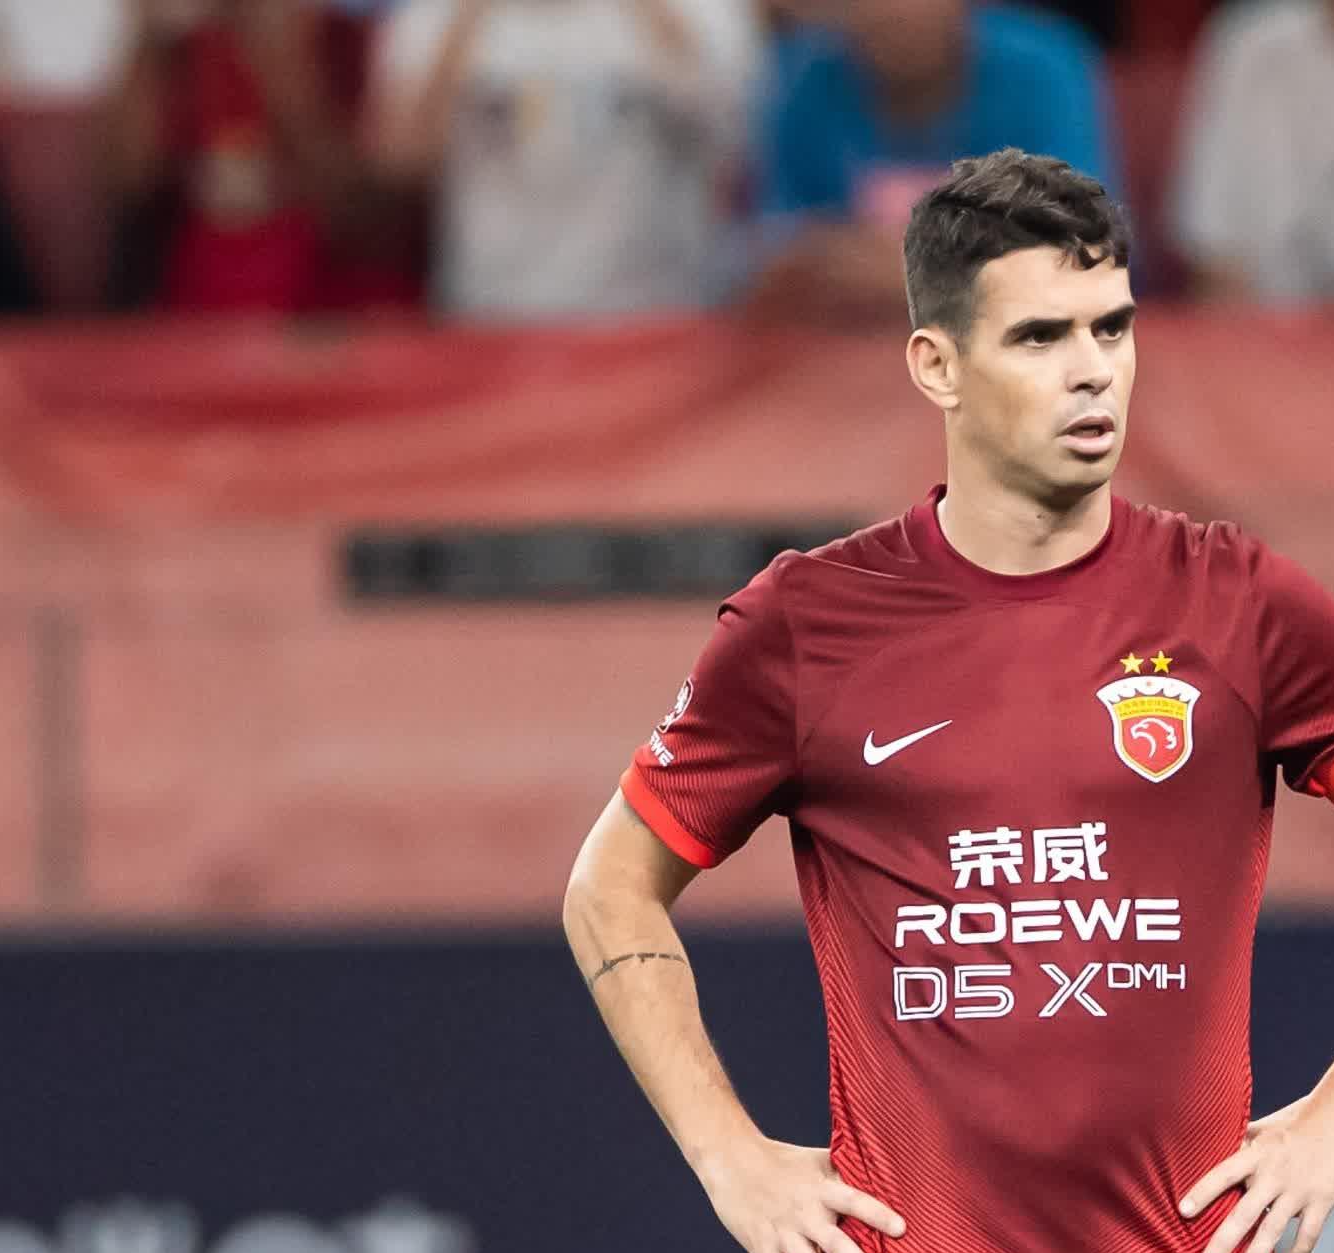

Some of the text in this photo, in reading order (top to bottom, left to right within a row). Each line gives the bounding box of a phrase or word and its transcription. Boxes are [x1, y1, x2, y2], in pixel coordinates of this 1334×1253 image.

[948, 821, 1109, 889] 荣威
[894, 898, 1182, 948] ROEWE
[892, 963, 1015, 1021] D5
